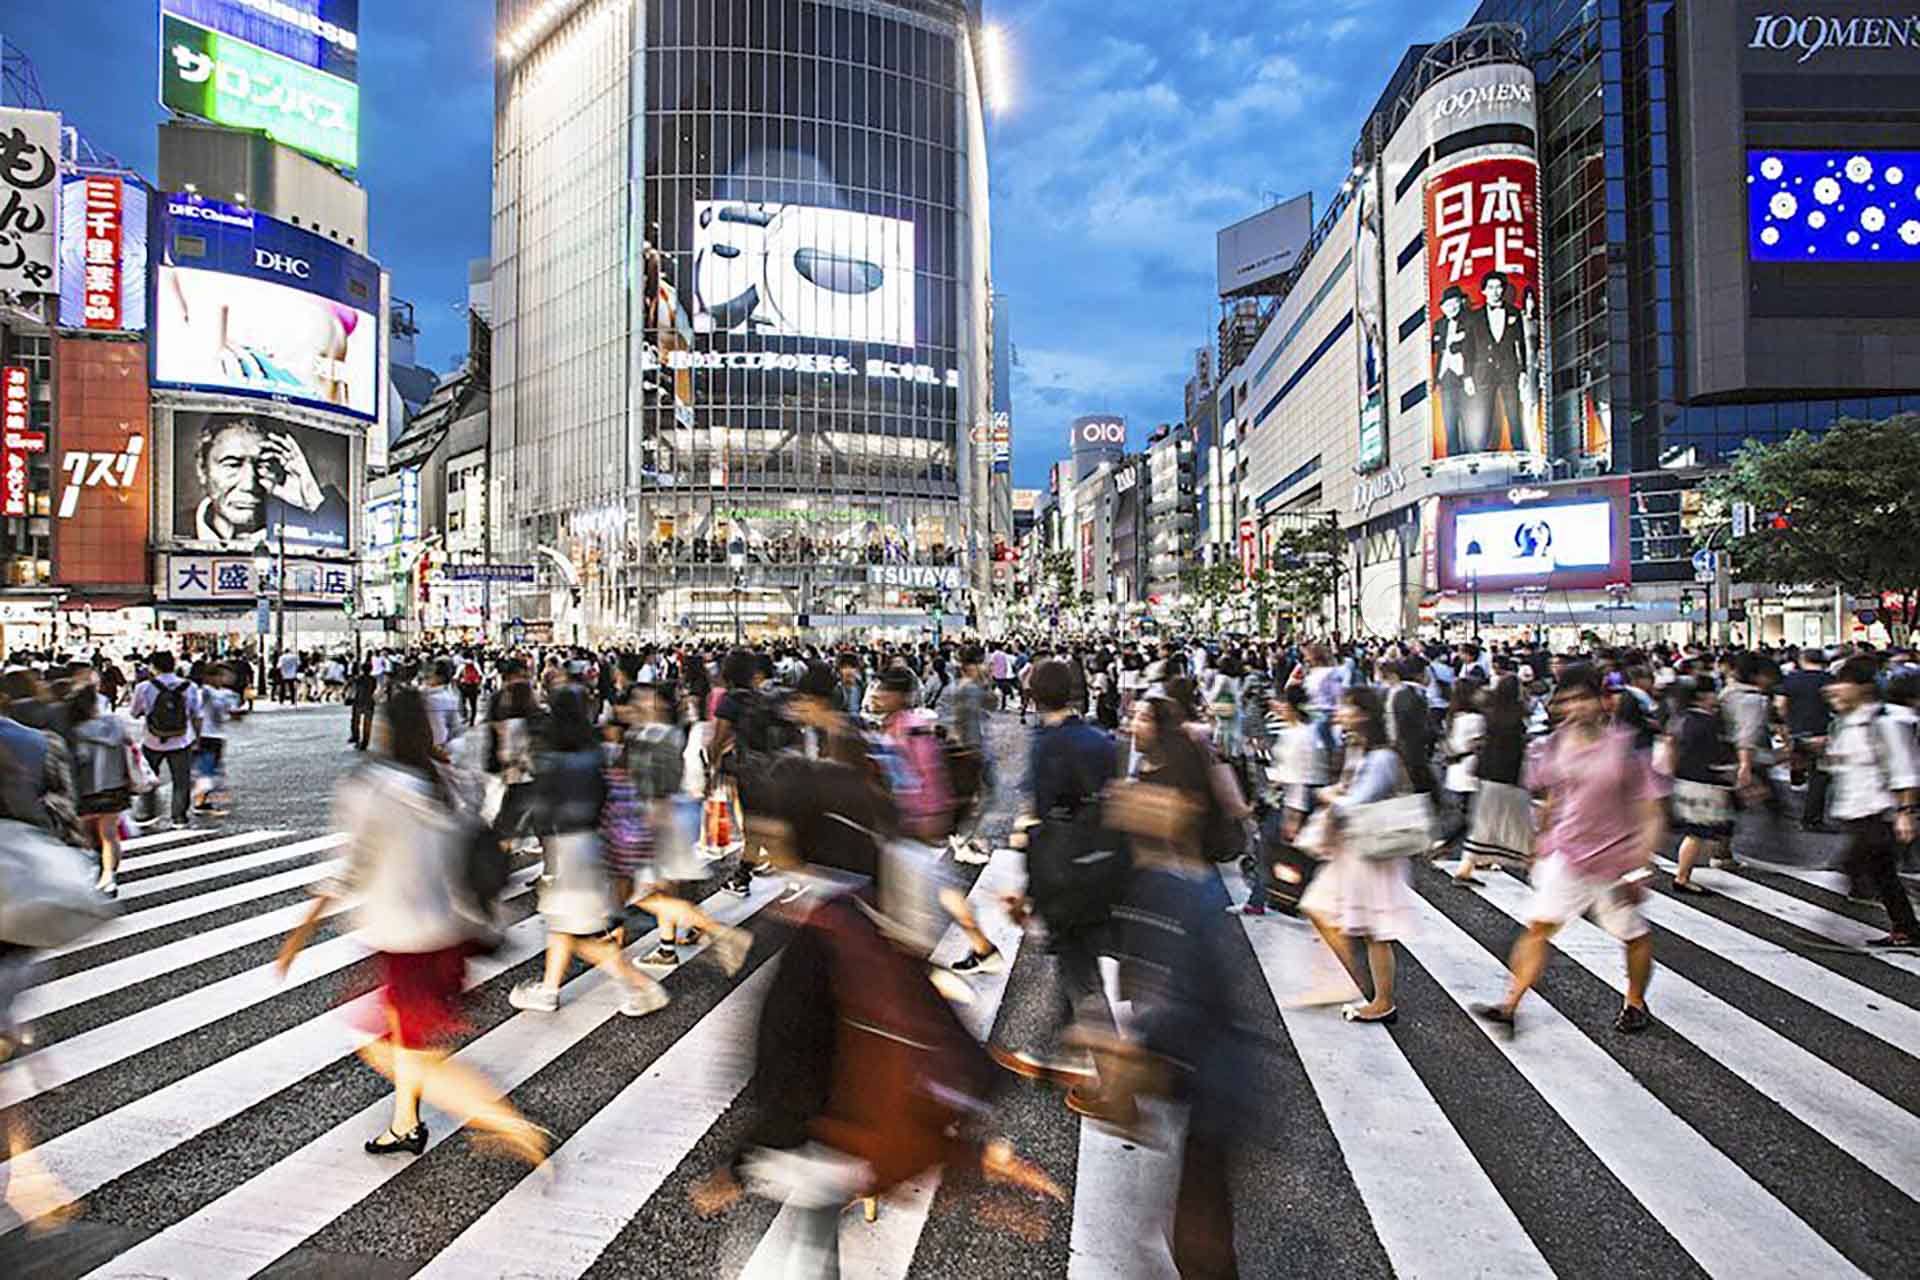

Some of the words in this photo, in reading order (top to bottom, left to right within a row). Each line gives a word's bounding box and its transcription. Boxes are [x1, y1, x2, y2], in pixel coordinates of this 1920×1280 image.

[172, 44, 347, 129] サロンパス
[169, 202, 200, 217] DHC
[1435, 176, 1523, 238] 日本
[255, 248, 310, 278] DHC
[1437, 227, 1536, 282] ダービー
[58, 434, 144, 518] クスリ
[178, 564, 346, 593] 大盛店
[872, 566, 958, 586] TSUTAYA
